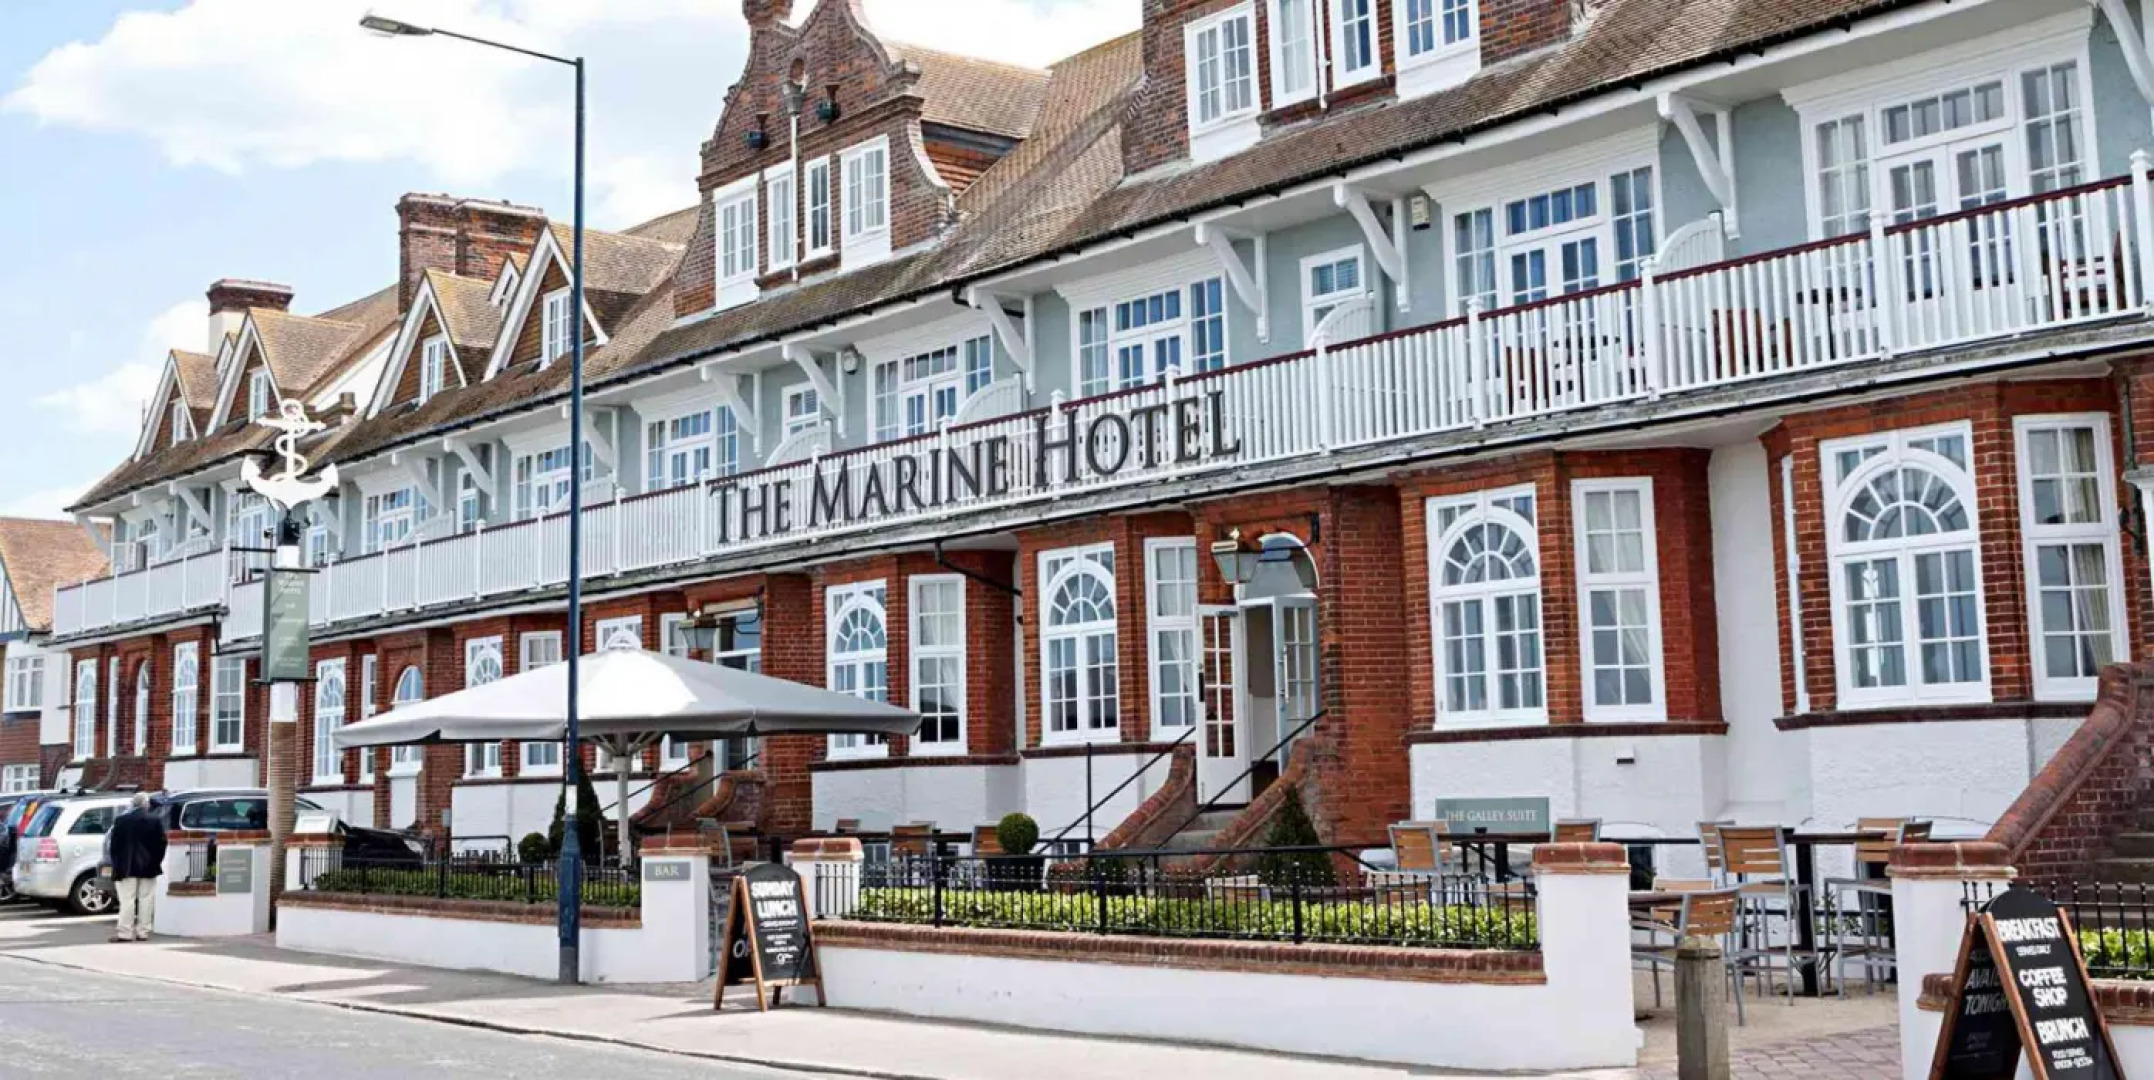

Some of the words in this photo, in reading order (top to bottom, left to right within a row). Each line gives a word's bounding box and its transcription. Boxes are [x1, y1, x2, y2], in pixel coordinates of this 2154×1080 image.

[709, 479, 791, 544] THE
[807, 436, 1009, 527] MARINE
[1035, 390, 1241, 488] HOTEL
[1446, 810, 1465, 821] THE
[1467, 810, 1506, 821] GALLEY
[1507, 810, 1537, 821] SUITE
[654, 864, 680, 877] BAR
[751, 880, 796, 898] SUNDAY
[756, 900, 798, 918] LUNCH
[1996, 917, 2061, 941] BREAKFAST
[2019, 967, 2066, 987] COFFEE
[2032, 987, 2067, 1008] SHOP
[2035, 1017, 2089, 1044] BRUNCH
